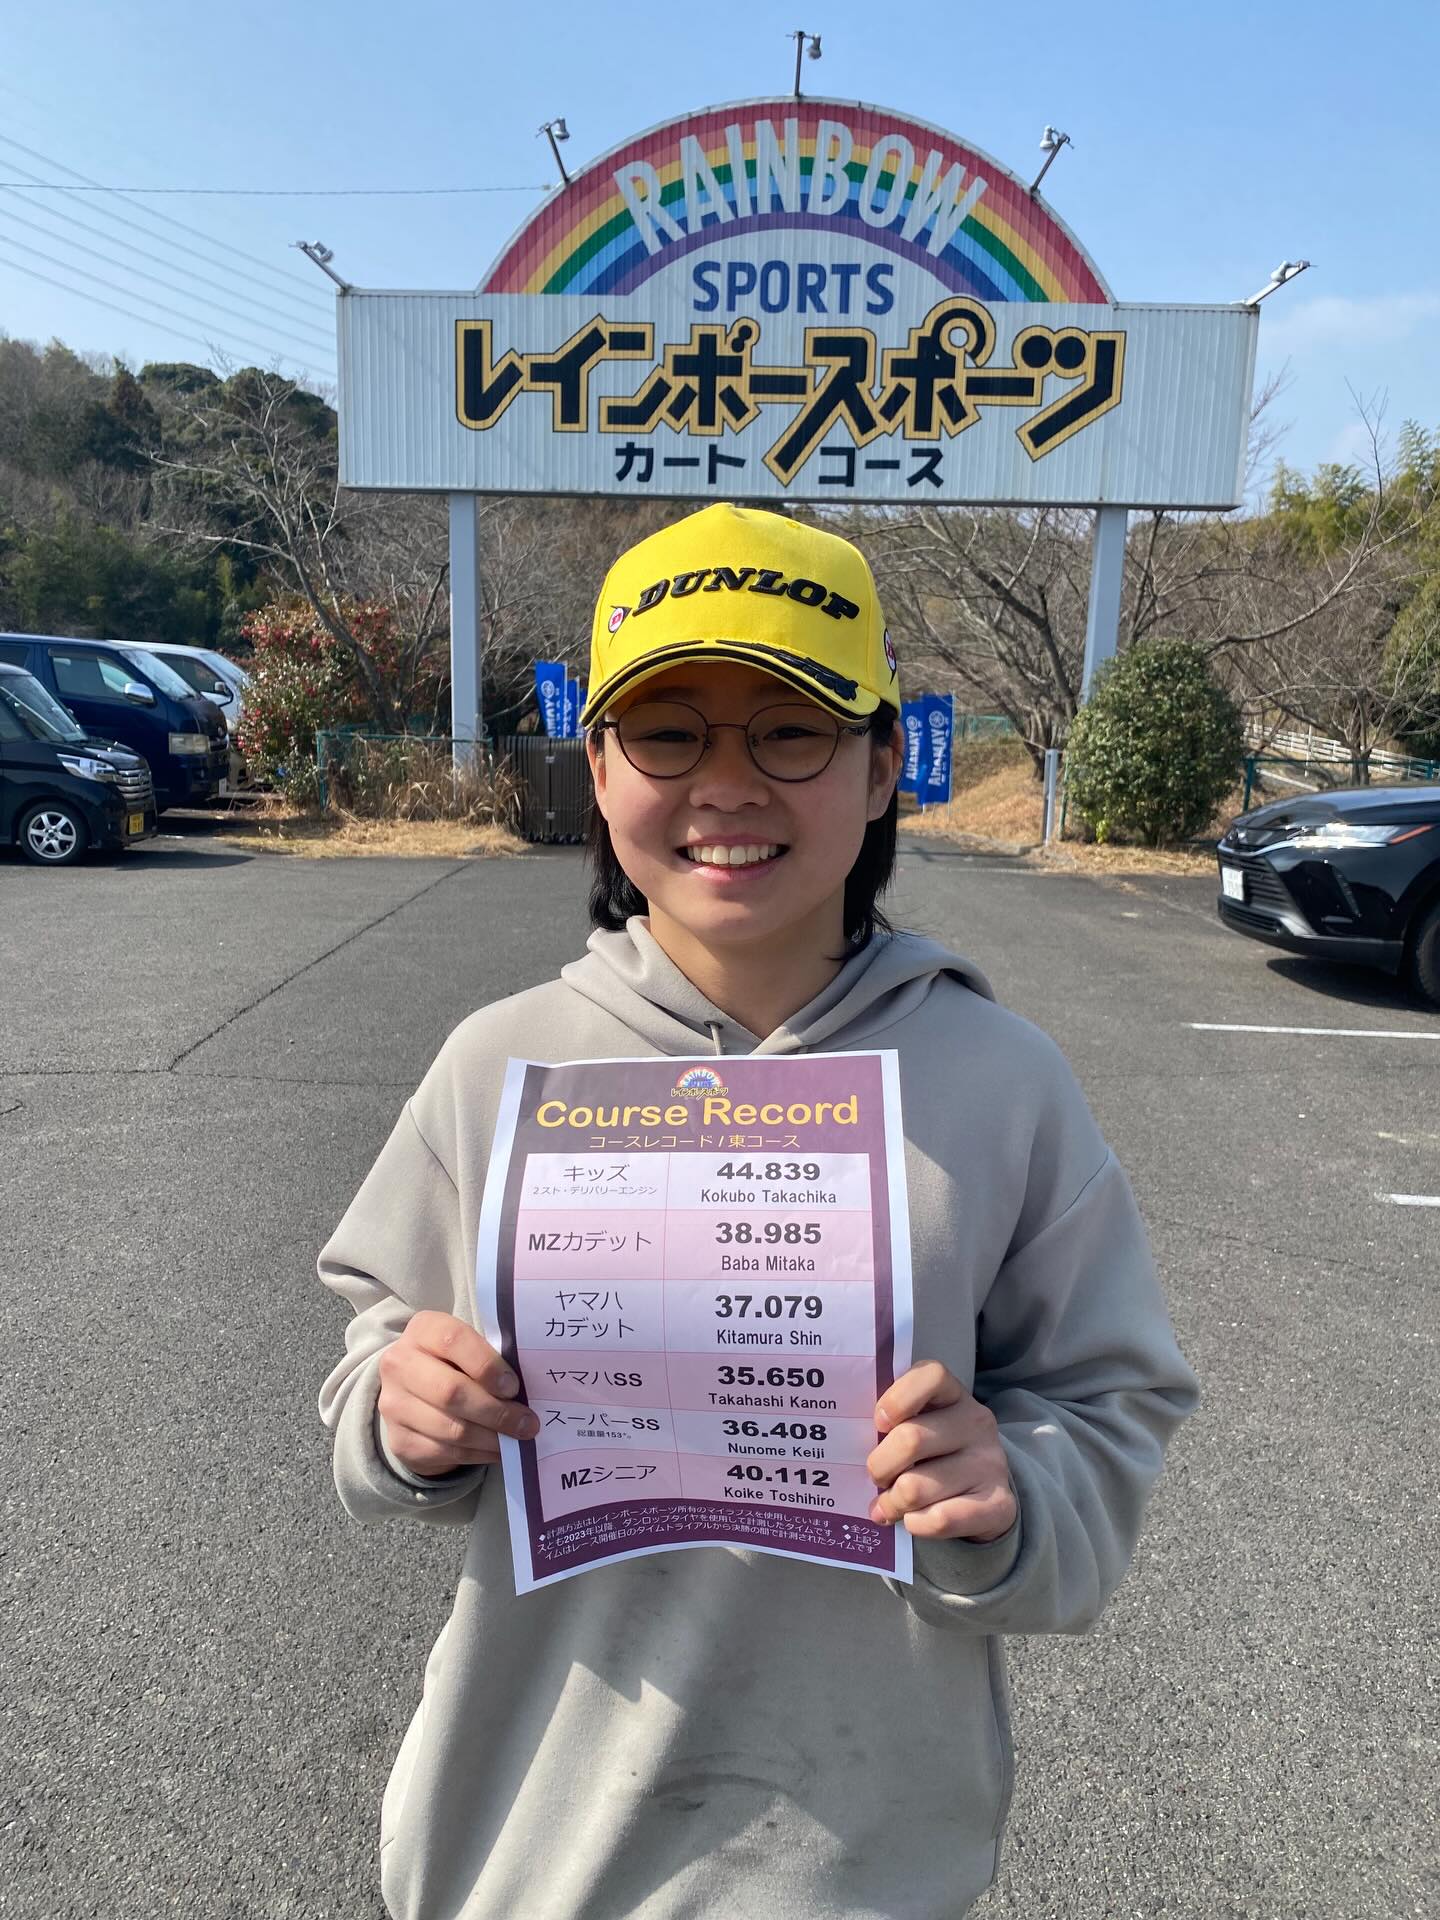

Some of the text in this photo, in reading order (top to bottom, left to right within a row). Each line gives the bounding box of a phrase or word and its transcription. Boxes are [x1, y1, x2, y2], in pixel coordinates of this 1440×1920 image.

[613, 116, 988, 256] RAINBOW
[692, 259, 895, 315] SPORTS
[455, 296, 1126, 487] レインボースポーツ
[614, 442, 944, 488] カート コース
[632, 567, 859, 620] DUNLOP
[537, 1093, 857, 1127] Course Record
[590, 1135, 712, 1149] コースレコード
[728, 1134, 800, 1148] 東コース
[564, 1164, 630, 1181] キッズ
[717, 1162, 820, 1180] 44.839
[701, 1189, 836, 1203] Kokubo Takachika
[529, 1230, 651, 1251] MZカデット
[716, 1222, 821, 1244] 38.985
[722, 1256, 815, 1271] Baba Mitaka
[555, 1291, 622, 1311] ヤマハ
[715, 1295, 822, 1319] 37.079
[546, 1317, 634, 1338] カデット
[717, 1329, 822, 1345] Kitamura Shin
[546, 1369, 642, 1387] ヤマハSS
[718, 1366, 824, 1387] 35.650
[709, 1392, 836, 1409] Takahashi Kanon
[545, 1409, 660, 1431] スーパーSS
[722, 1420, 827, 1440] 36.408
[728, 1442, 825, 1459] Nunome Keiji
[560, 1463, 657, 1491] MZシニア
[726, 1464, 831, 1488] 40.112
[724, 1485, 836, 1508] Koike Toshihiro
